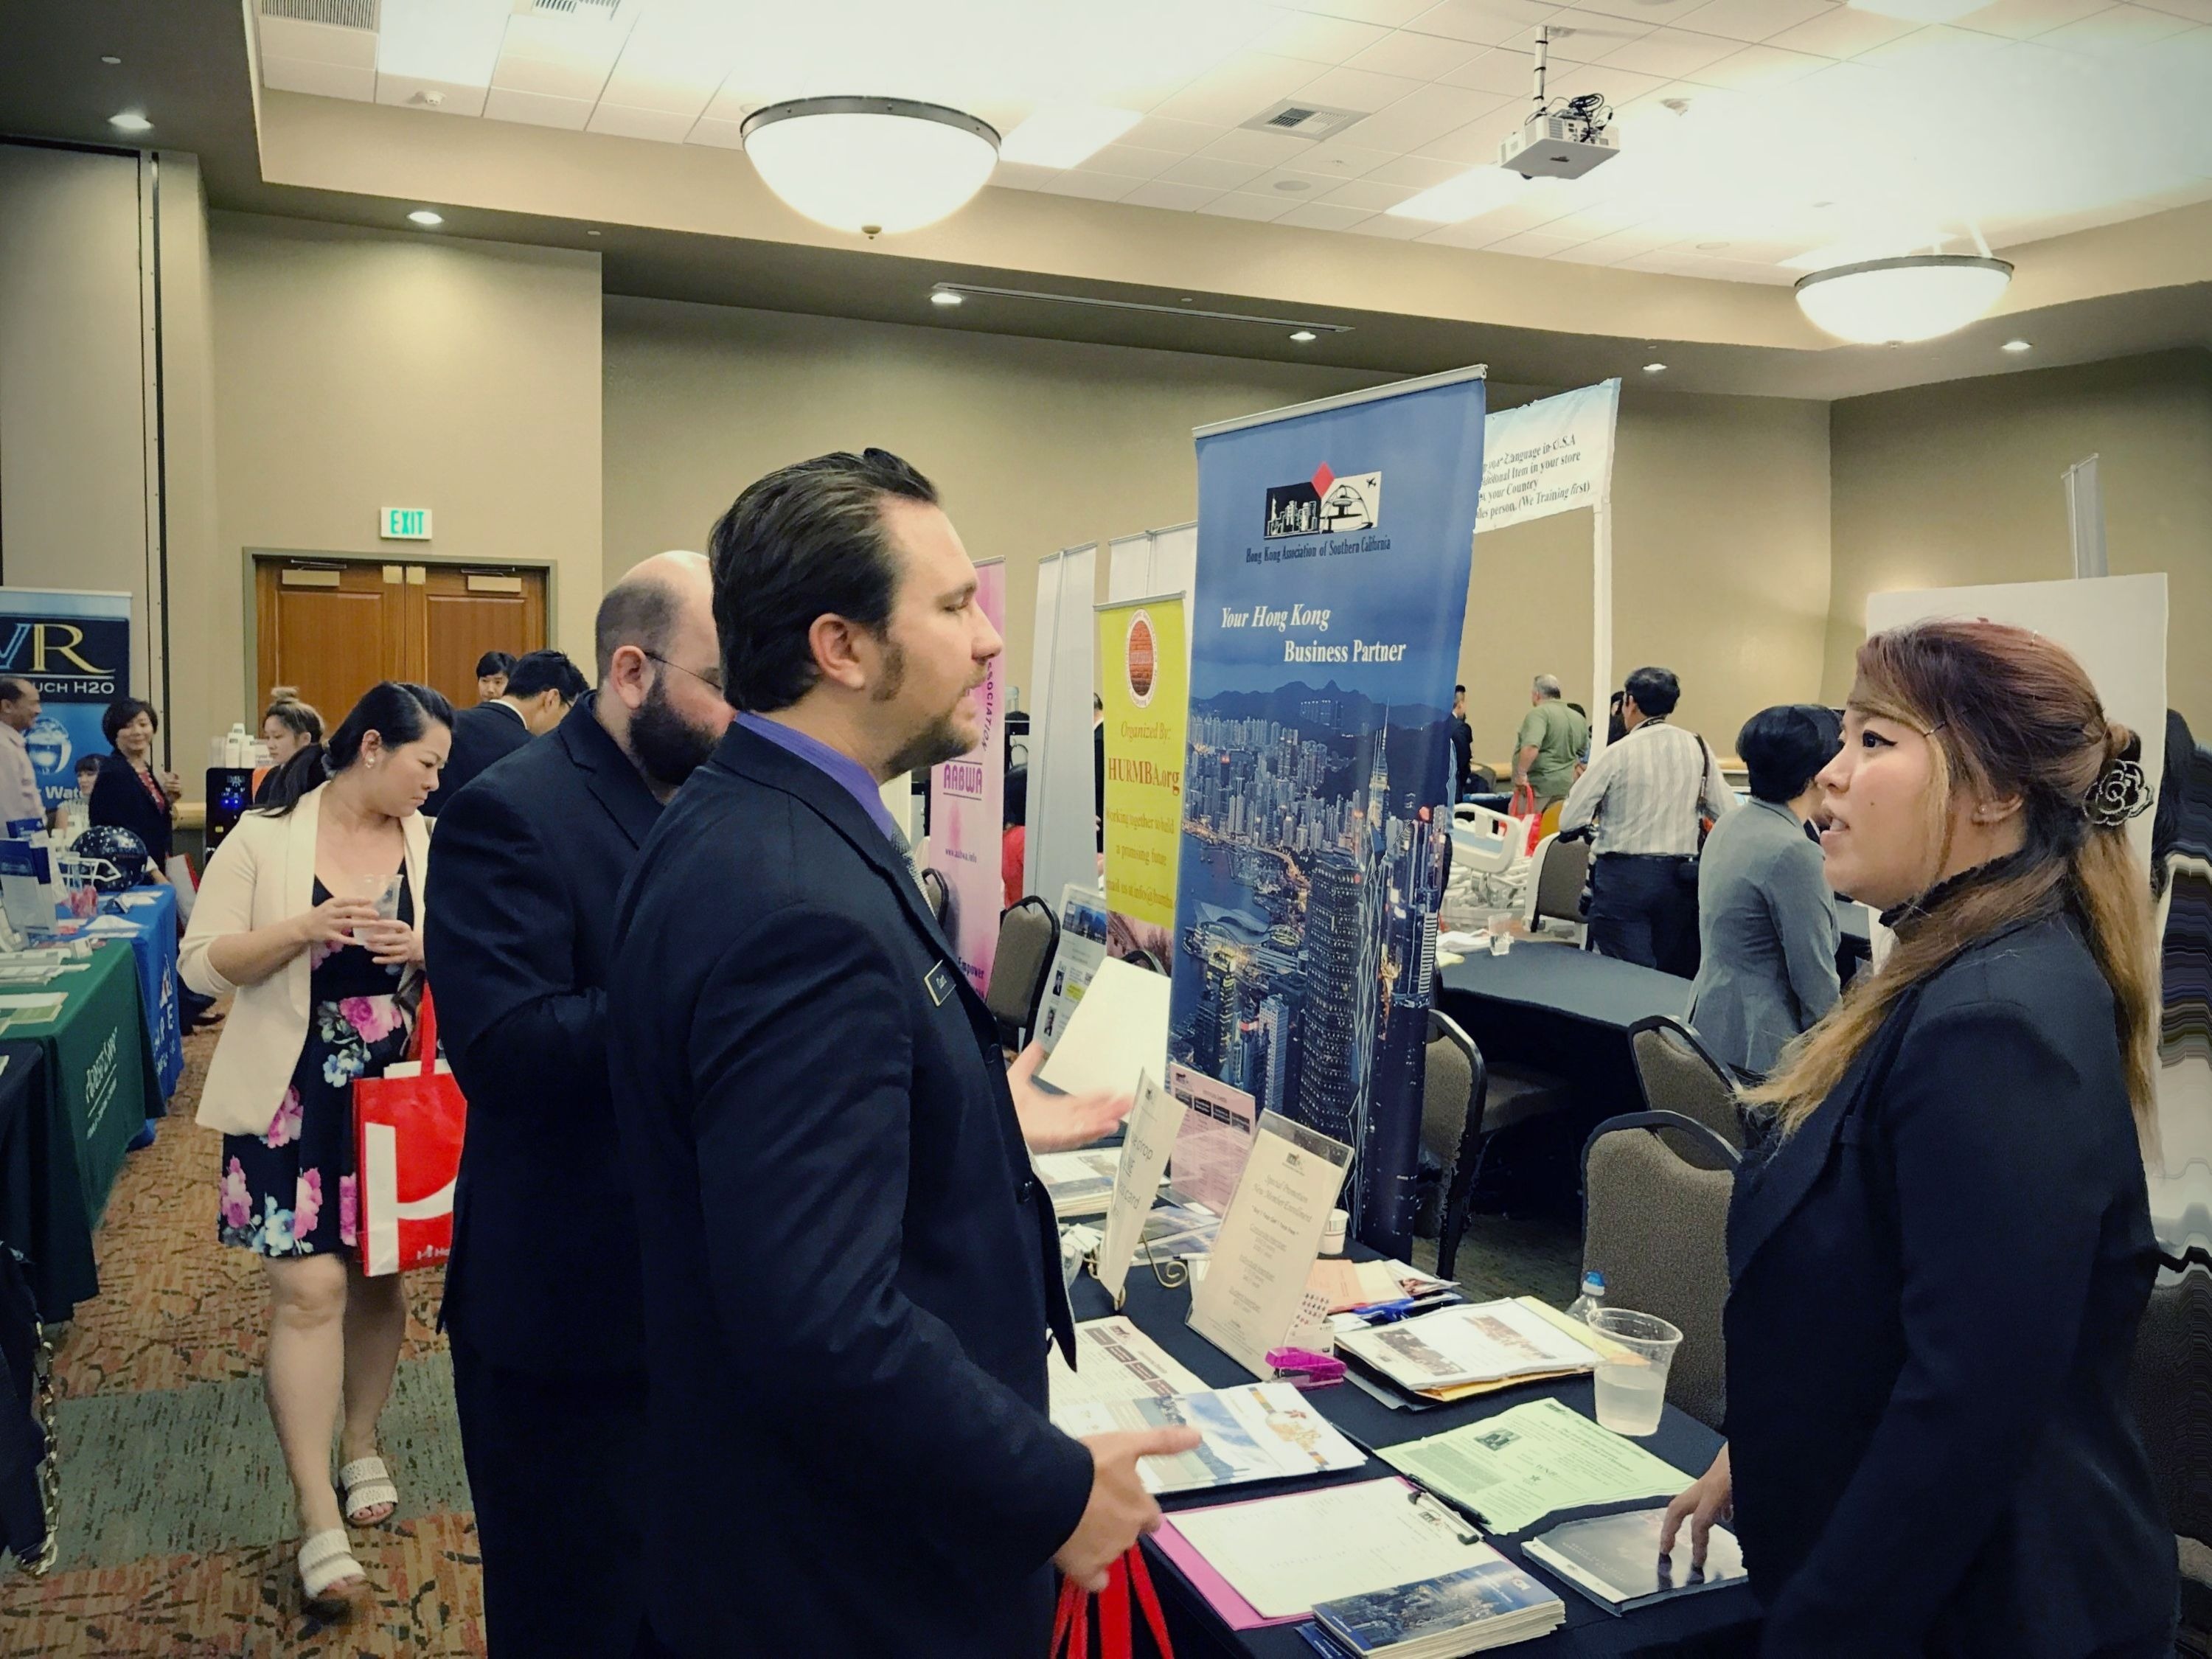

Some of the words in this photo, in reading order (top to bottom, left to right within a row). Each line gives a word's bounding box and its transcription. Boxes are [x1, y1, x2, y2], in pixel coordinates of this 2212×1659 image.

[1512, 466, 1528, 478] Item
[1531, 462, 1538, 473] in
[1540, 457, 1559, 474] your
[1561, 451, 1581, 465] store
[1489, 488, 1505, 504] your
[1506, 479, 1539, 495] Country
[1490, 502, 1517, 520] person.
[1519, 495, 1534, 511] (We
[1536, 487, 1569, 505] Training
[1571, 480, 1590, 496] first)
[390, 509, 424, 535] EXIT
[1246, 548, 1262, 564] Hong
[1265, 546, 1281, 563] Kong
[1282, 543, 1317, 560] Association
[1320, 540, 1328, 557] of
[1329, 538, 1360, 555] Southern
[1361, 535, 1391, 552] California
[1221, 607, 1249, 628] Your
[1251, 605, 1288, 633] Hong
[1290, 604, 1331, 632] Kong
[1284, 640, 1348, 663] Business
[1352, 639, 1407, 663] Partner
[1121, 721, 1158, 742] Organized
[944, 764, 982, 793] AABWA
[1108, 757, 1180, 796] HURMBA.org
[1116, 845, 1120, 855] a
[1136, 1138, 1154, 1163] drop
[1123, 1189, 1141, 1210] card
